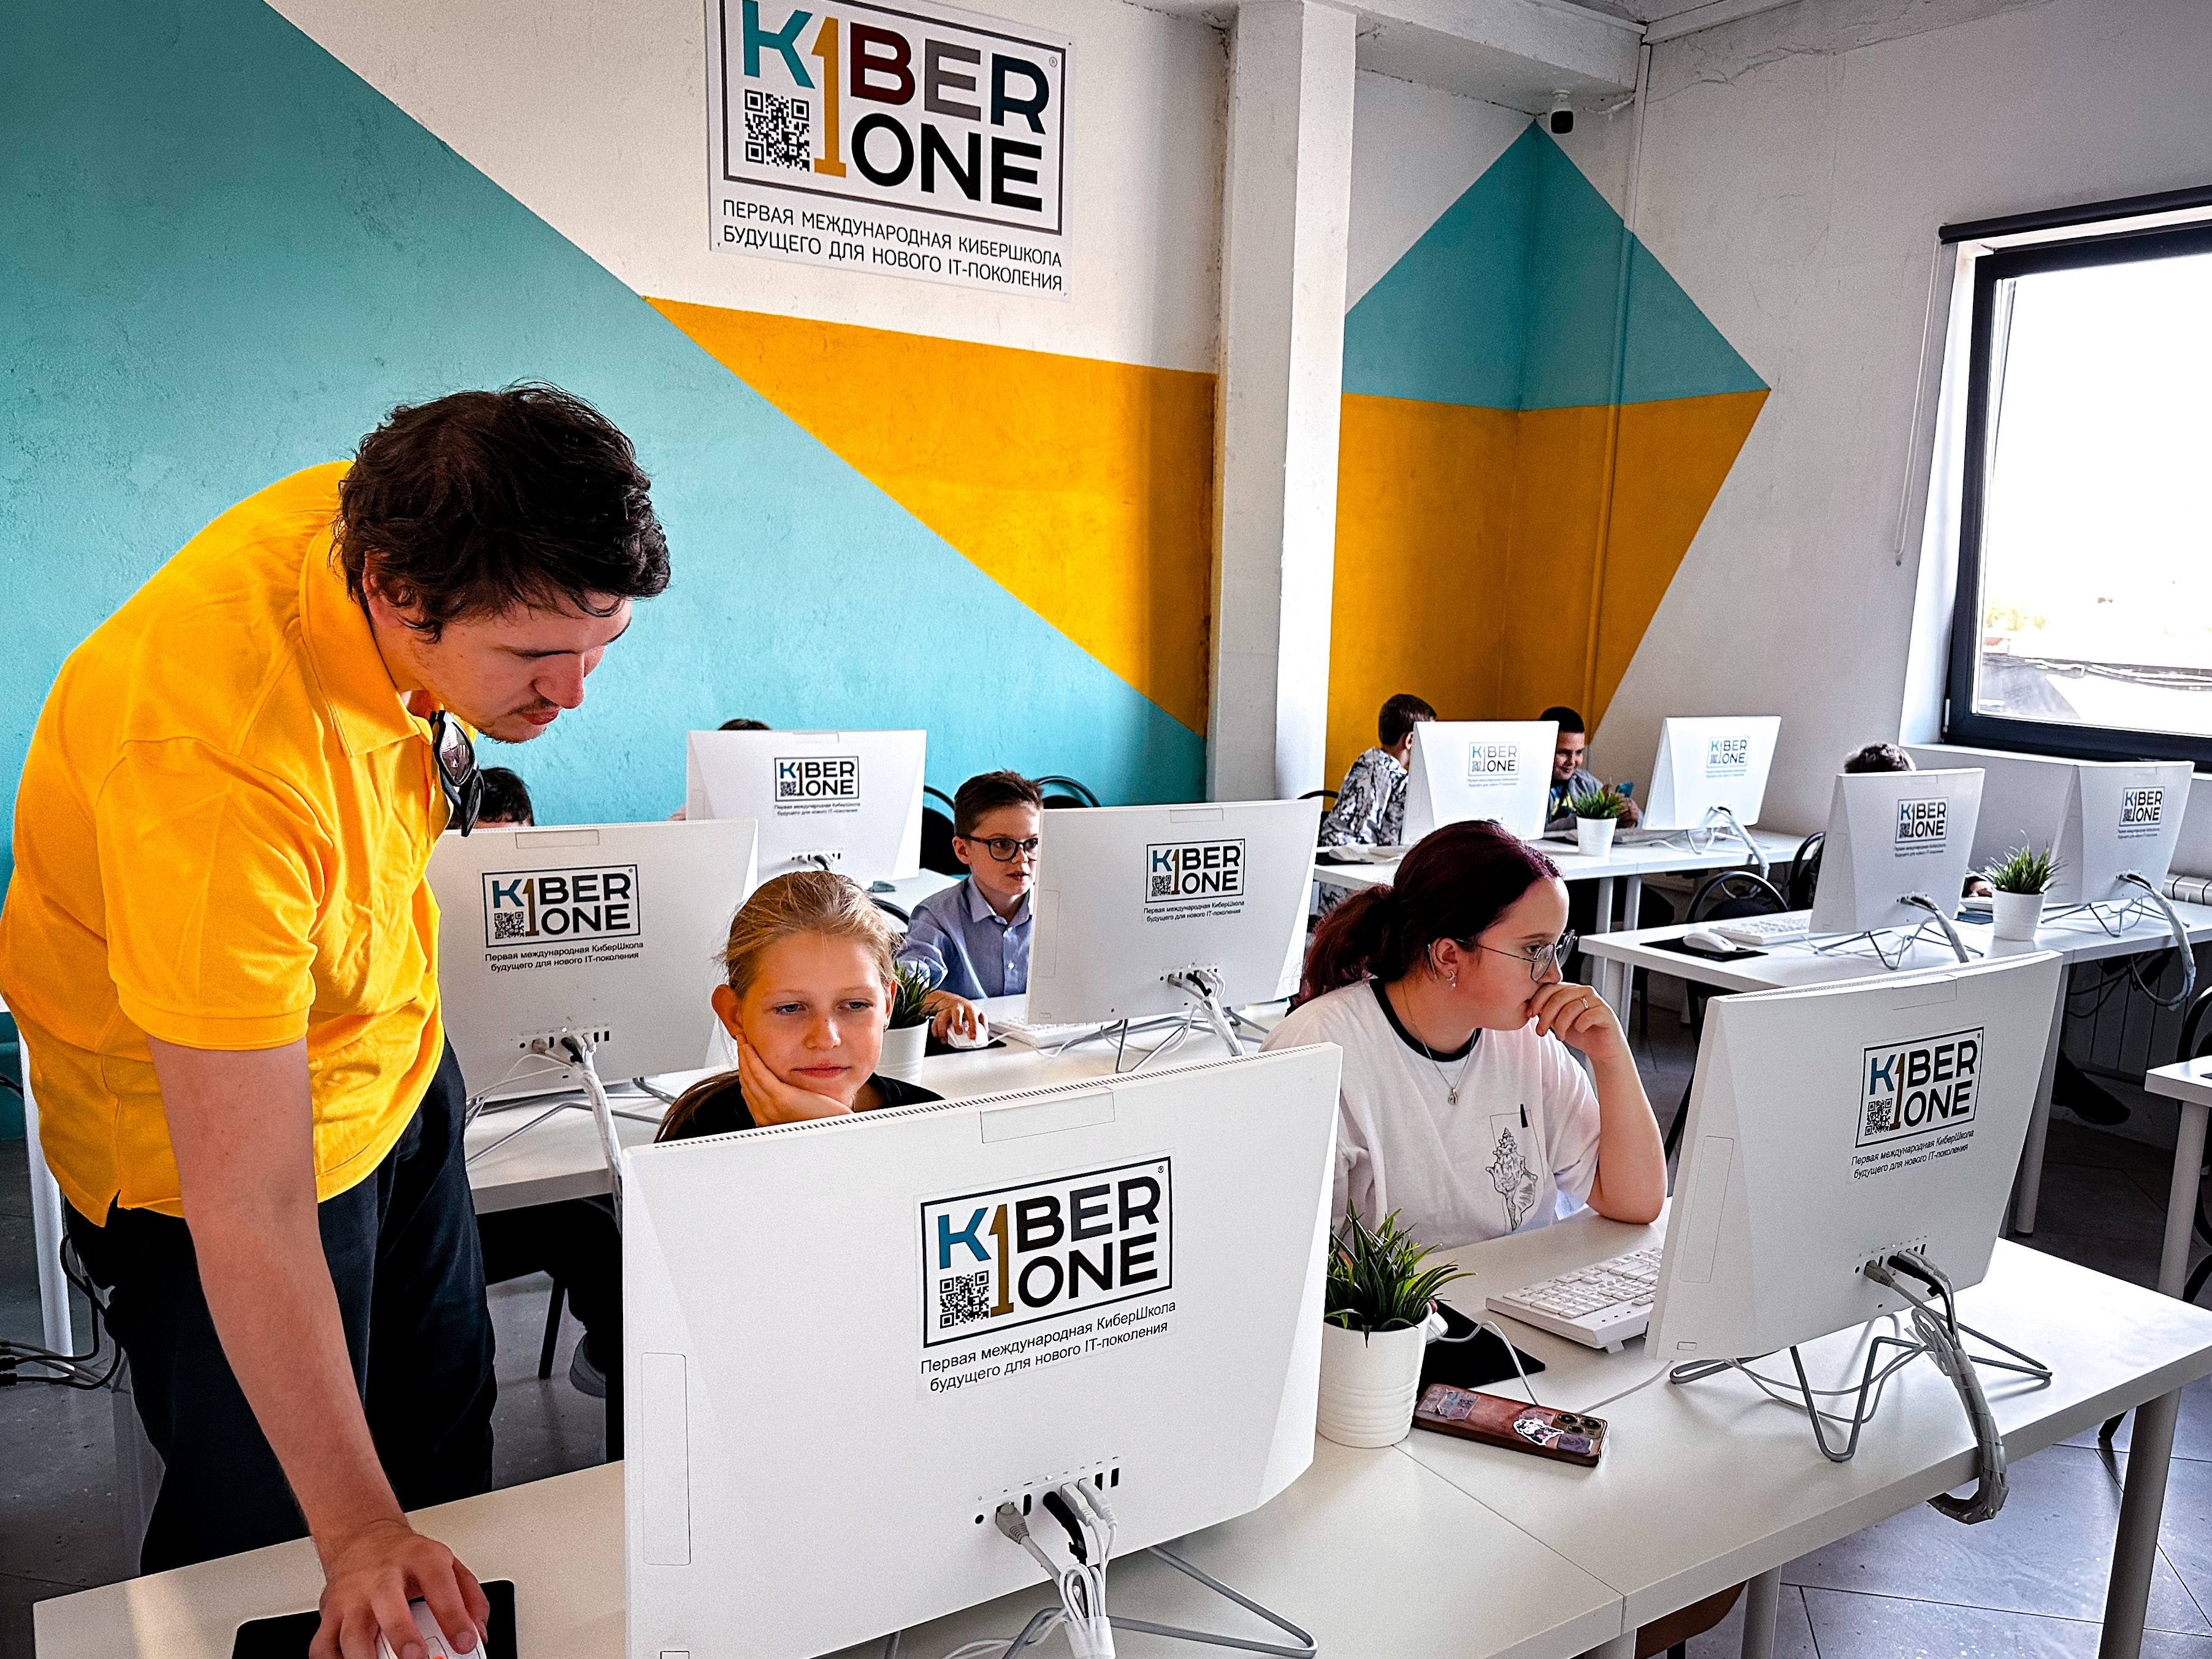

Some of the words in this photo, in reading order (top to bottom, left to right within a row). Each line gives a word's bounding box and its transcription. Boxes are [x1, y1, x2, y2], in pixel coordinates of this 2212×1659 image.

[851, 112, 1043, 212] ONE
[723, 199, 794, 226] ПЕРВАЯ
[802, 211, 951, 250] МЕЖДУНАРОДНАЯ
[959, 236, 1062, 267] КИБЕРШКОЛА
[724, 224, 822, 255] БУДУЩЕГО
[829, 240, 864, 261] ДЛЯ
[873, 247, 941, 272] НОВОГО
[949, 258, 1062, 291] IT-ПОКОЛЕНИЯ
[1487, 760, 1516, 772] ONE
[1721, 753, 1745, 764] ONE
[805, 779, 854, 796] ONE
[1915, 820, 1945, 837] ONE
[2136, 807, 2160, 822] ONE
[1182, 870, 1239, 894] ONE
[541, 903, 630, 935] ONE
[485, 952, 518, 962] Первая
[521, 945, 589, 959] международная
[592, 941, 644, 952] КиберШкола
[491, 961, 533, 973] будущего
[535, 960, 552, 968] для
[554, 957, 583, 966] нового
[585, 952, 639, 964] IT-поколения
[1904, 1079, 1973, 1127] ONE
[1851, 1152, 1879, 1166] Первая
[1880, 1139, 1935, 1160] международная
[1936, 1129, 1975, 1146] КиберШкола
[1854, 1163, 1888, 1180] будущего
[1889, 1160, 1903, 1172] для
[1904, 1154, 1927, 1167] нового
[1928, 1143, 1969, 1162] IT-поколения
[1017, 1232, 1158, 1308] ONE
[920, 1350, 976, 1374] Первая
[981, 1321, 1093, 1360] международная
[1096, 1301, 1176, 1331] КиберШкола
[930, 1364, 1001, 1393] будущего
[1003, 1358, 1031, 1376] для
[1035, 1341, 1081, 1365] нового
[1085, 1322, 1168, 1353] IT-поколения
